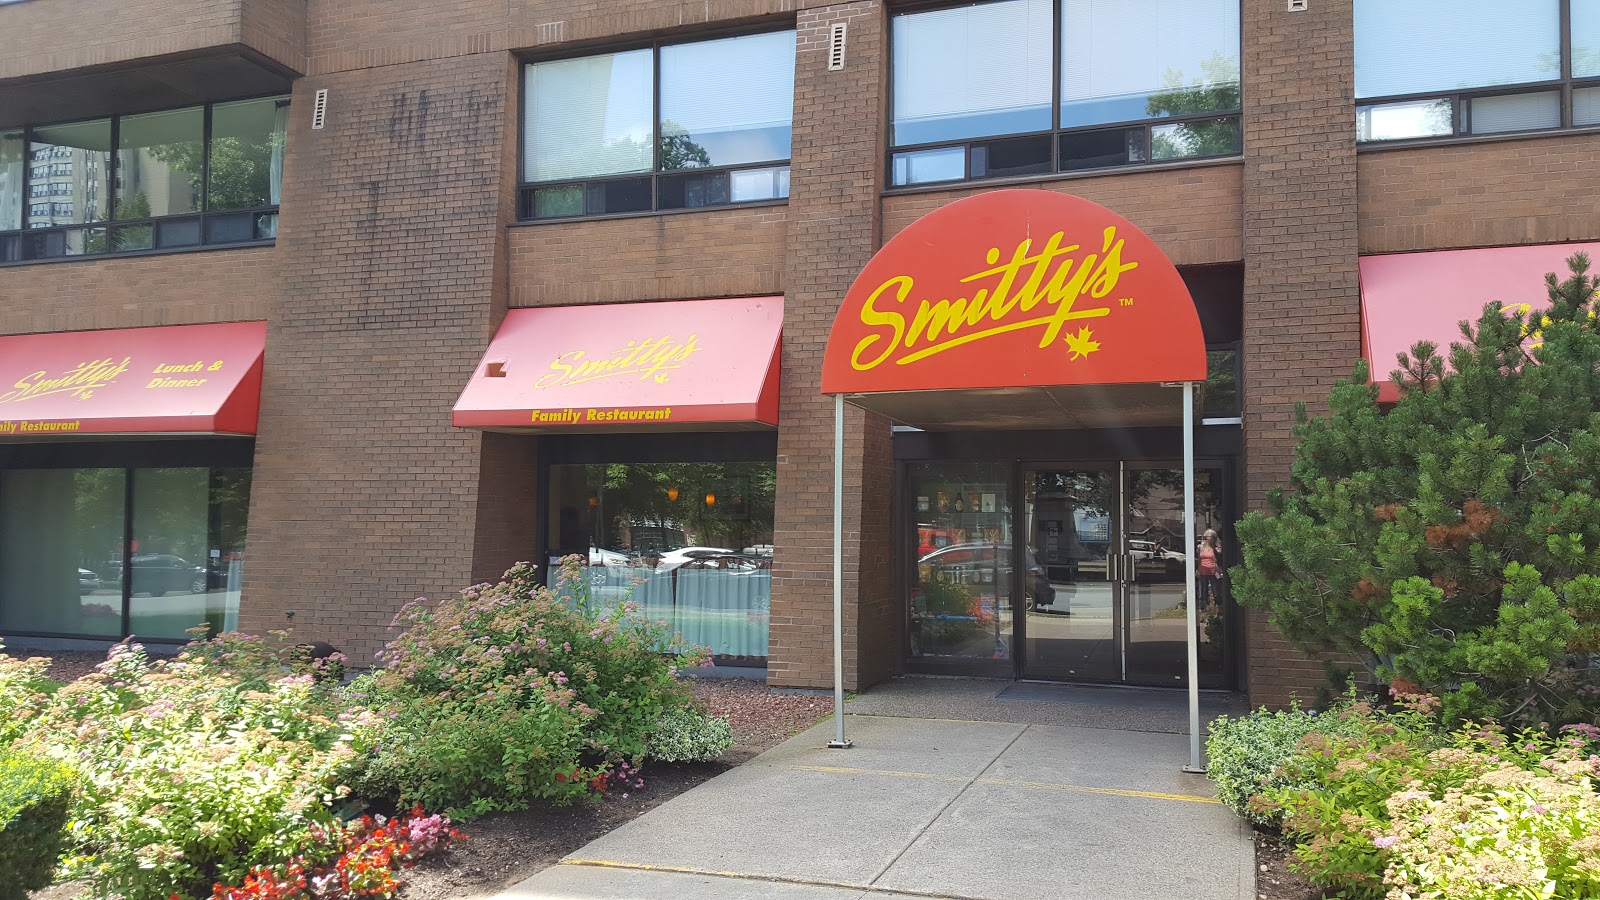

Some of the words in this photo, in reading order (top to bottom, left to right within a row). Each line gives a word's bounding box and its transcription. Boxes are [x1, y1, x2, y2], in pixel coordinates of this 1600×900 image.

[851, 226, 1138, 371] Smitty's
[1118, 297, 1134, 307] TM
[152, 360, 204, 374] Lunch
[207, 360, 224, 372] &
[534, 333, 702, 389] Smitty's
[0, 356, 131, 403] Smitty's
[145, 376, 208, 389] Dinner
[531, 408, 582, 424] Family
[586, 407, 672, 421] Restaurant
[20, 420, 80, 432] Restaurant
